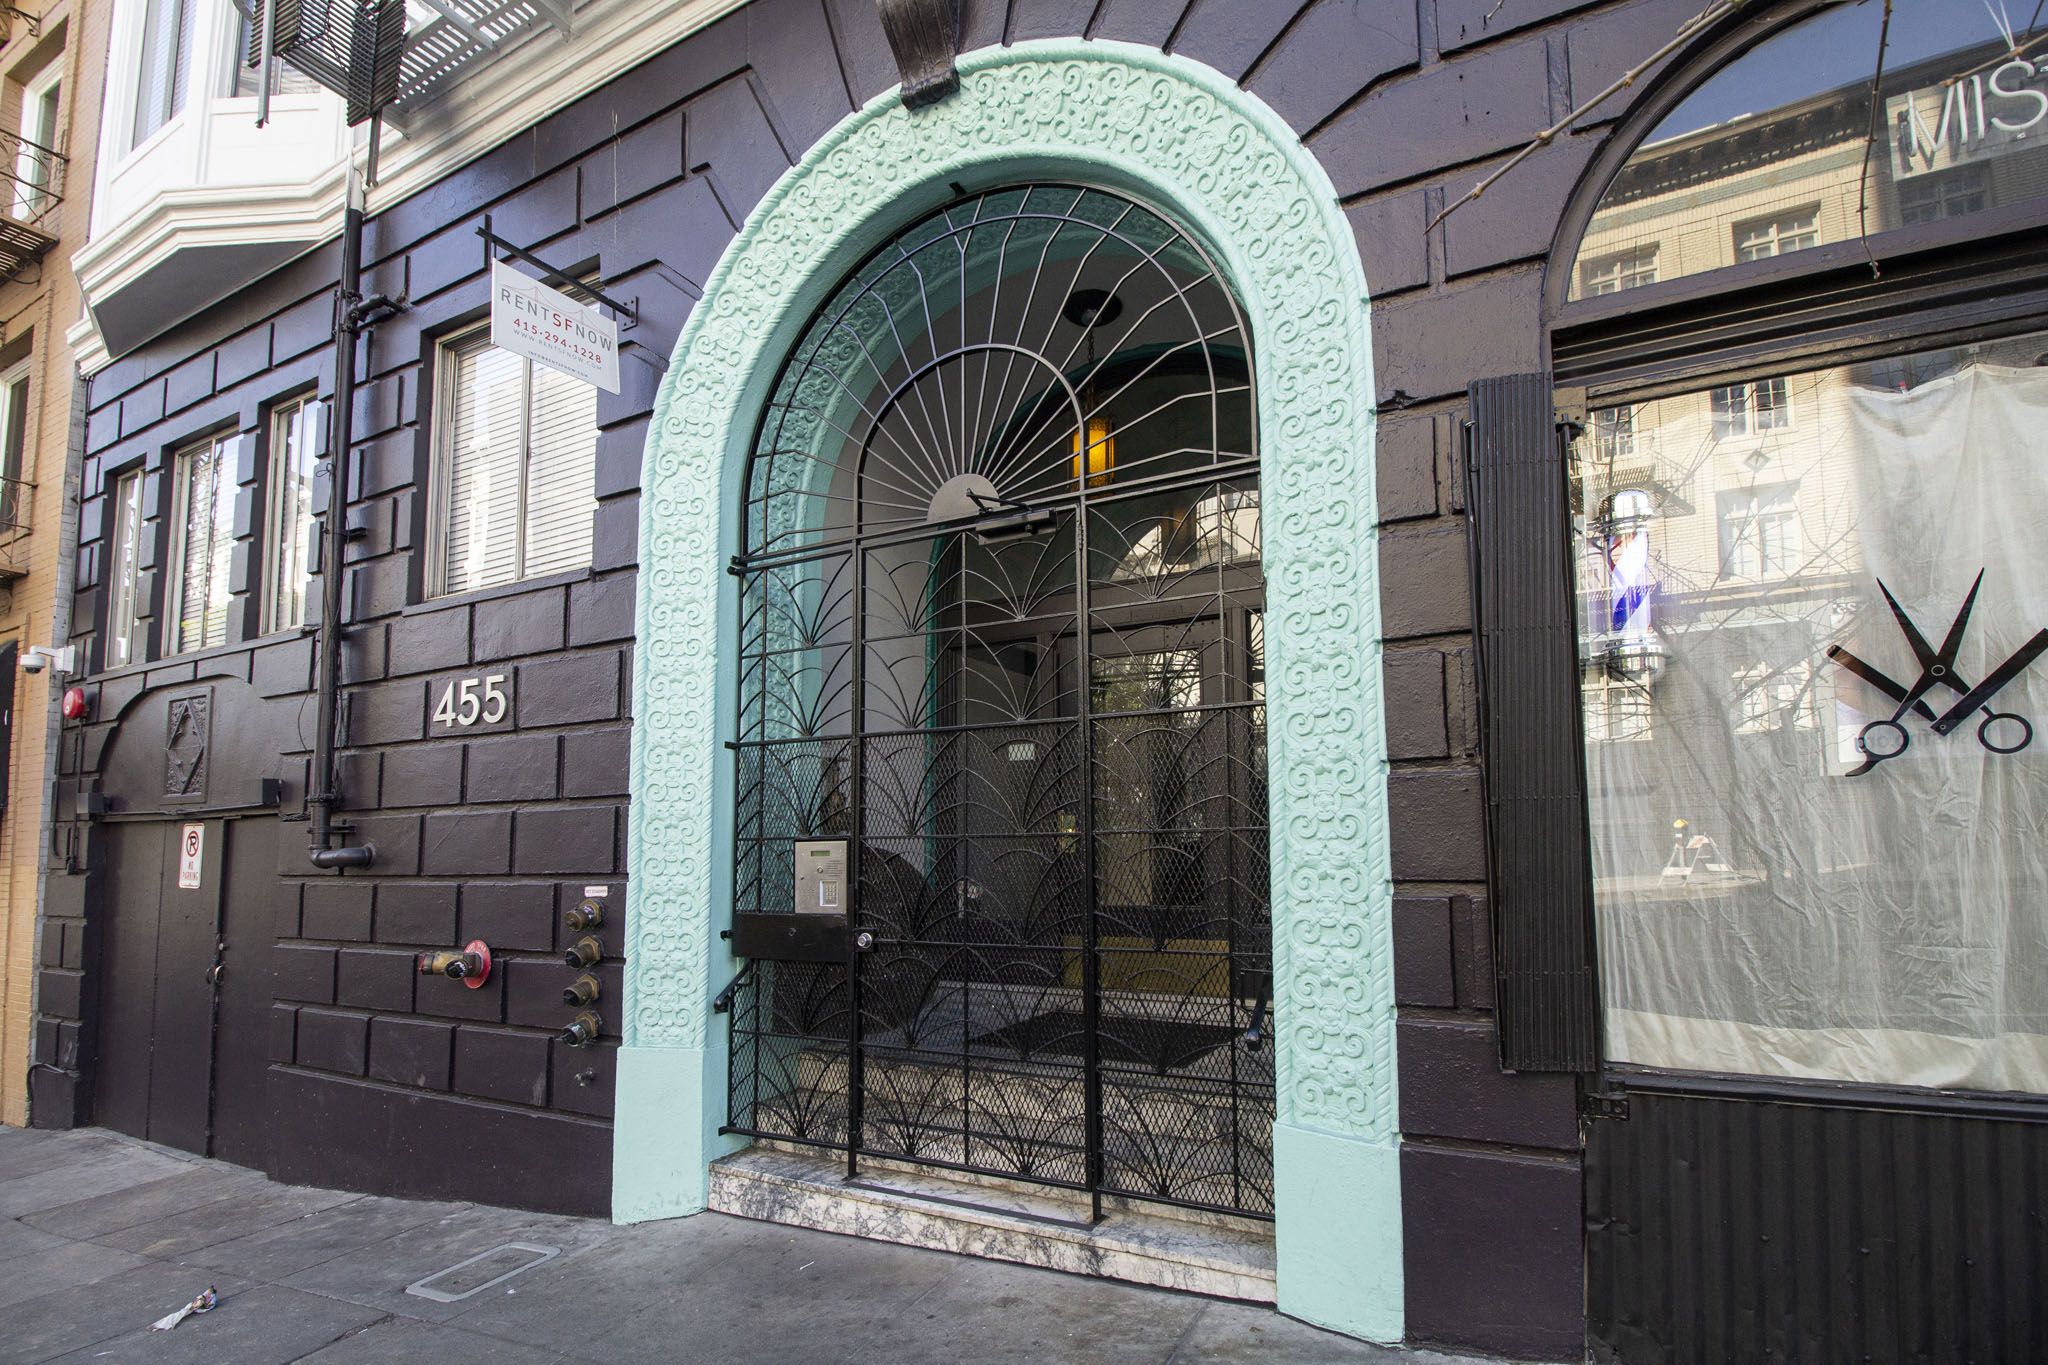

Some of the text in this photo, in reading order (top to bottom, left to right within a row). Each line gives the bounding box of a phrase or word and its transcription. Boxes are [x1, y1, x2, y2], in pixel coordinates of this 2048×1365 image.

[1907, 54, 2048, 157] MIS
[501, 287, 612, 352] RENTSFNOW
[432, 674, 506, 728] 455
